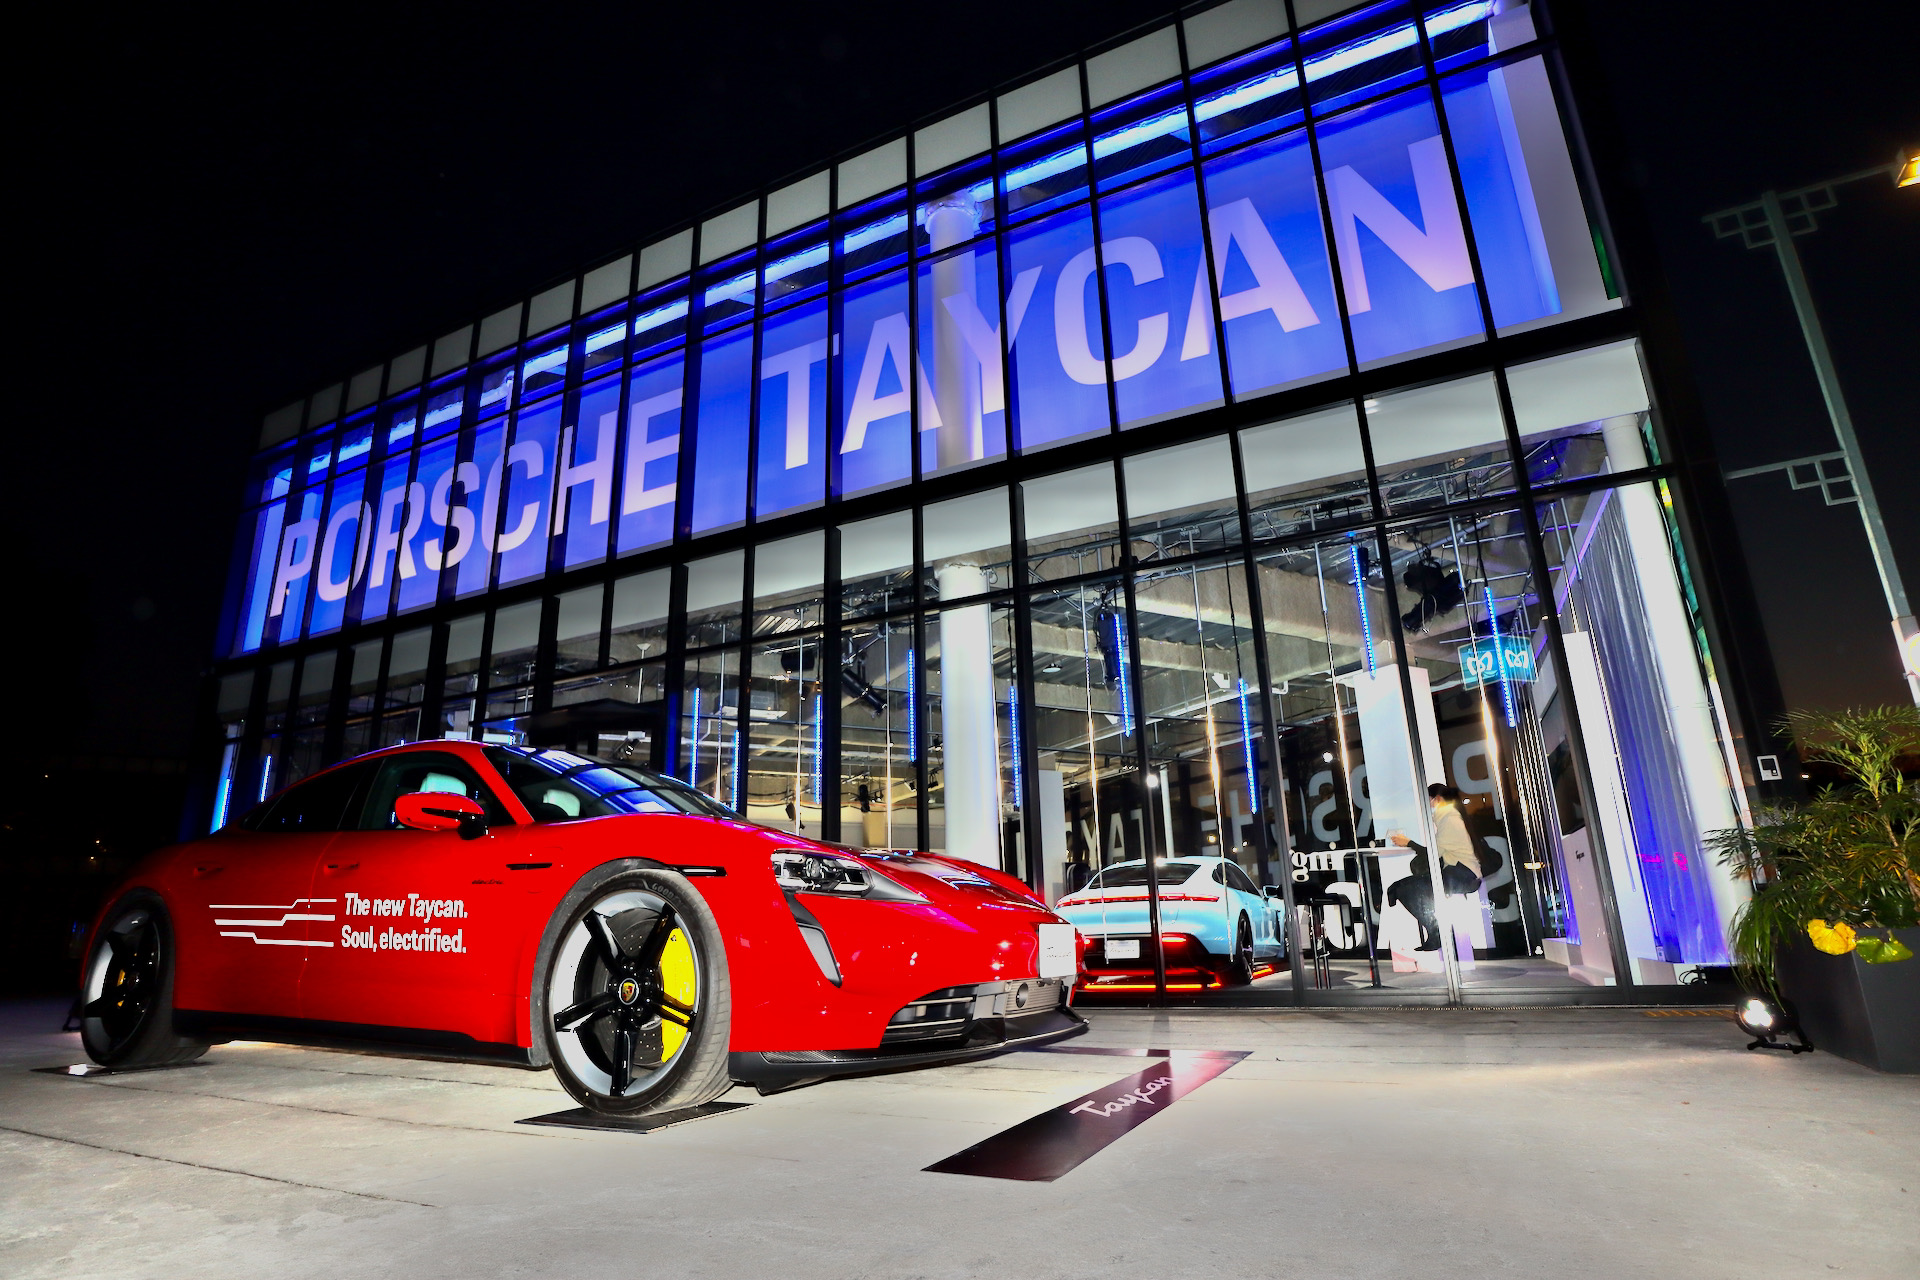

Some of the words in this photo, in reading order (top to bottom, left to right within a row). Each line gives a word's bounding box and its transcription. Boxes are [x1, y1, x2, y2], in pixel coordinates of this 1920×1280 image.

[269, 387, 683, 617] PORSCHE
[760, 134, 1476, 470] TAYCAN
[344, 892, 371, 916] The
[372, 899, 406, 917] new
[407, 893, 468, 924] Taycan.
[341, 924, 378, 953] Soul,
[379, 926, 467, 954] electrified.
[1069, 1075, 1175, 1117] Taycan
